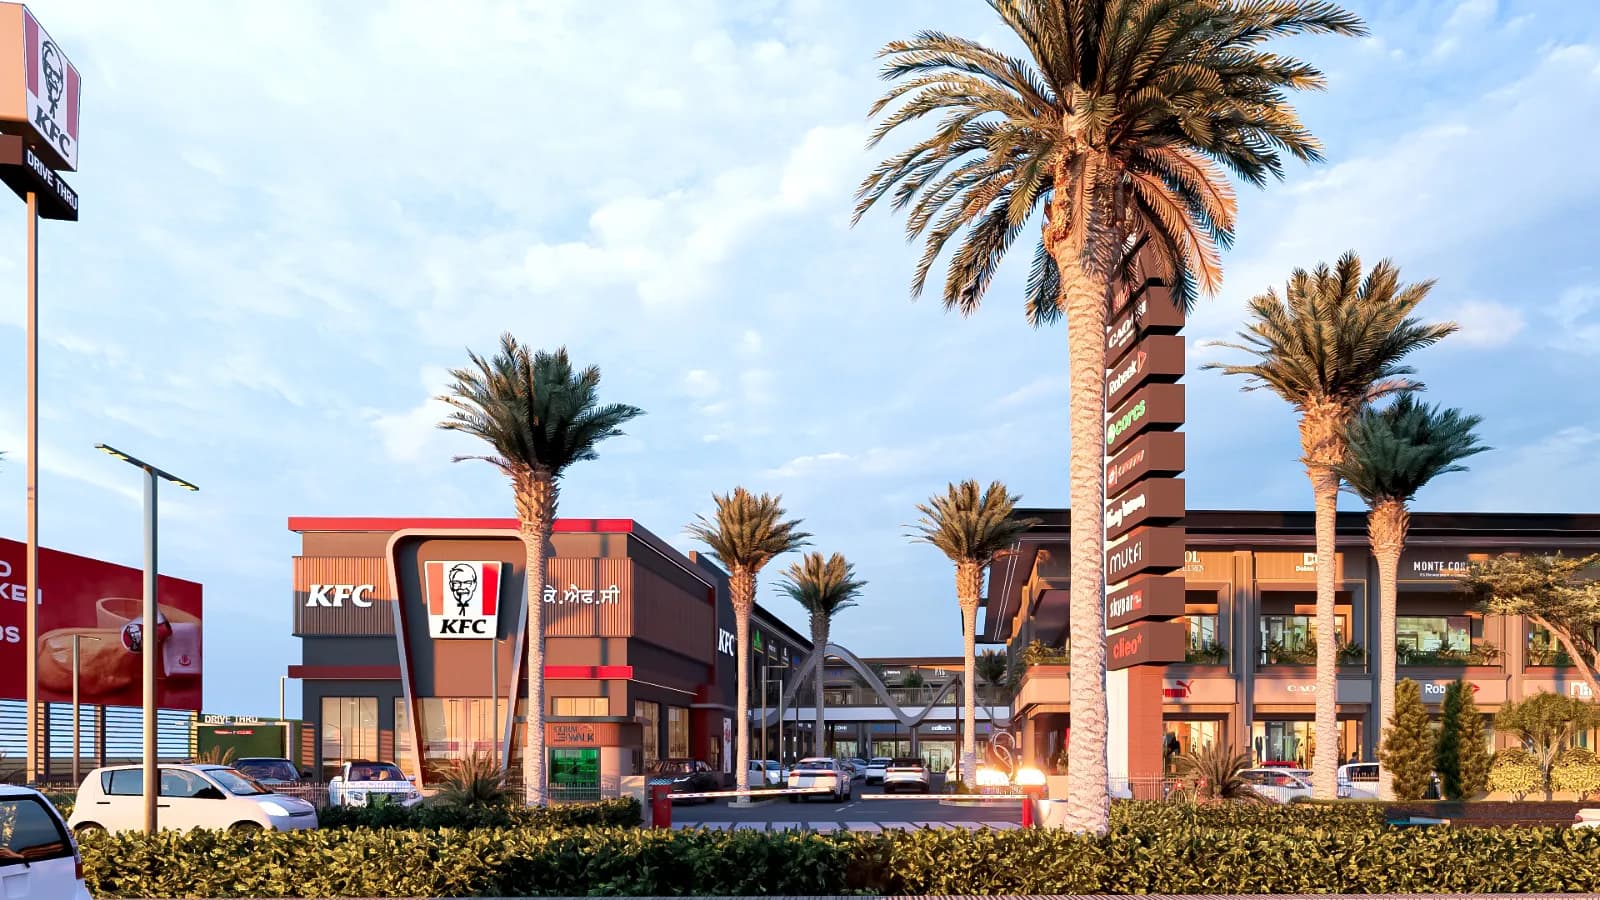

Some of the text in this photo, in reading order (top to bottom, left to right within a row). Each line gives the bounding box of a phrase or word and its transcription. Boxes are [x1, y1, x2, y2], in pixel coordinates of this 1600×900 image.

[35, 104, 70, 158] KFC
[27, 148, 78, 210] DRIVE THRU
[1413, 561, 1444, 571] MONTE
[305, 584, 375, 608] KFC
[440, 618, 487, 634] KFC
[718, 628, 736, 657] KFC
[1424, 683, 1446, 695] Rob
[204, 714, 232, 724] DRIVE
